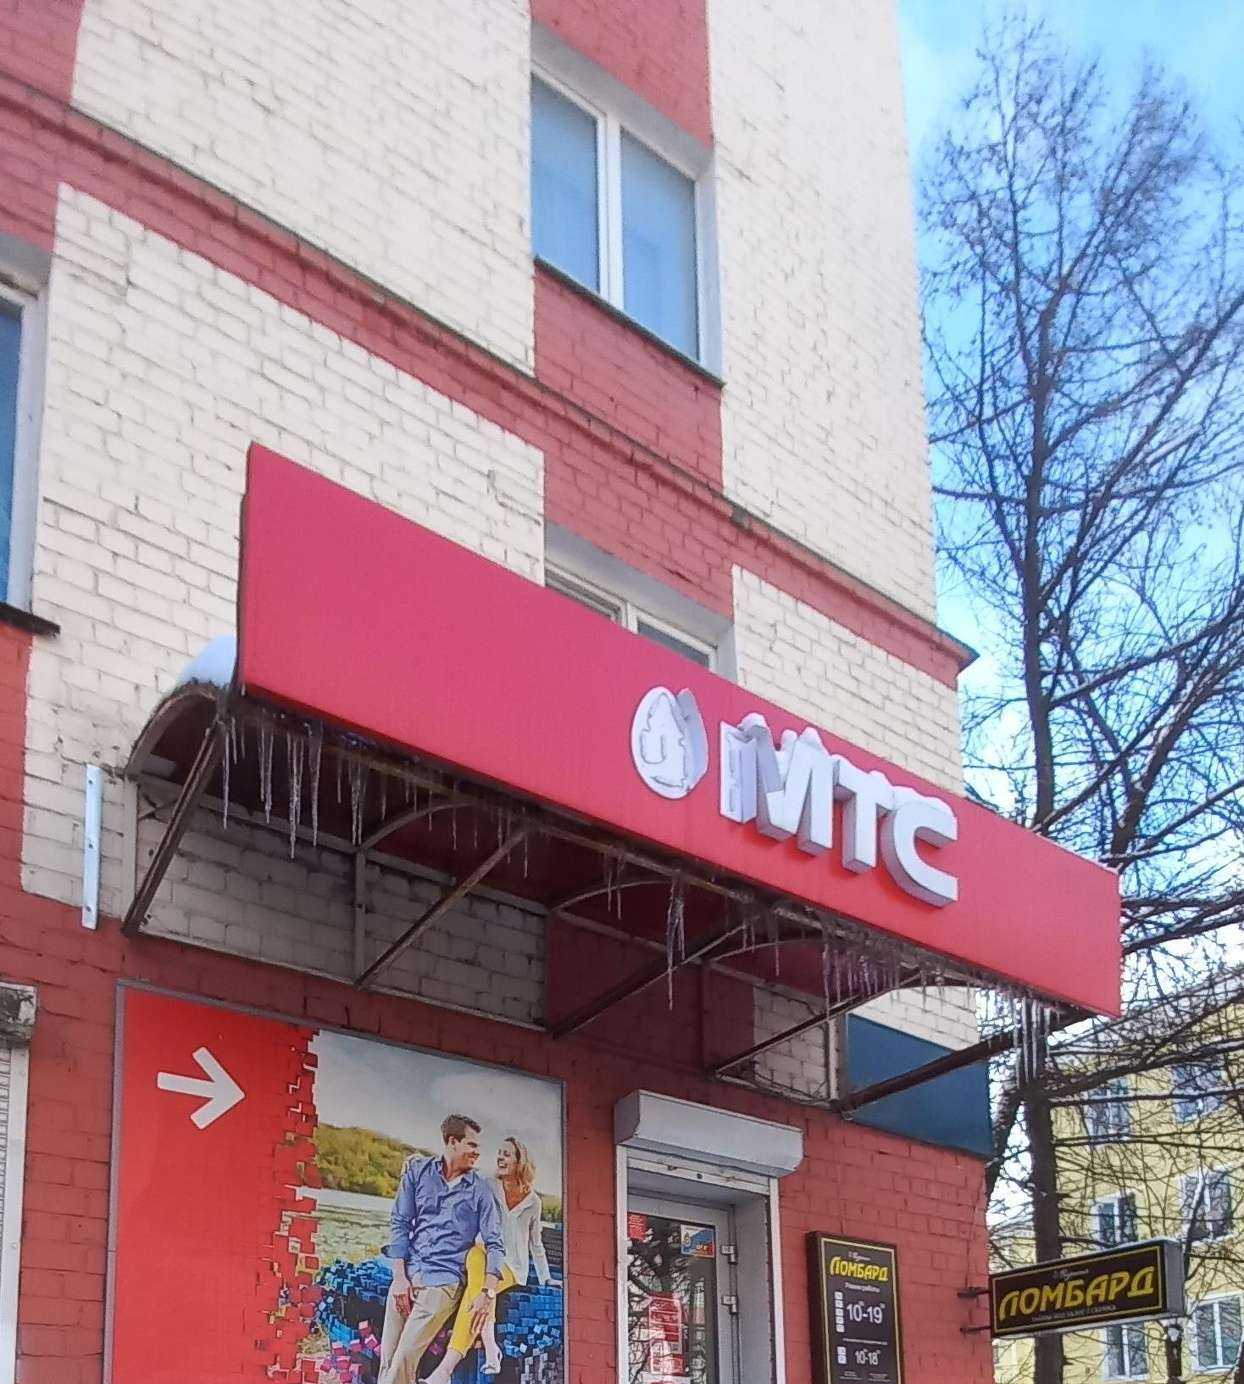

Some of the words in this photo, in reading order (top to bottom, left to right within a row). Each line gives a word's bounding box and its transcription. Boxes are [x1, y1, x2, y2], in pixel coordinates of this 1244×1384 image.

[720, 713, 958, 908] МТС
[830, 1256, 888, 1281] ЛОМБАРД
[1000, 1266, 1154, 1320] ЛОМБАРД
